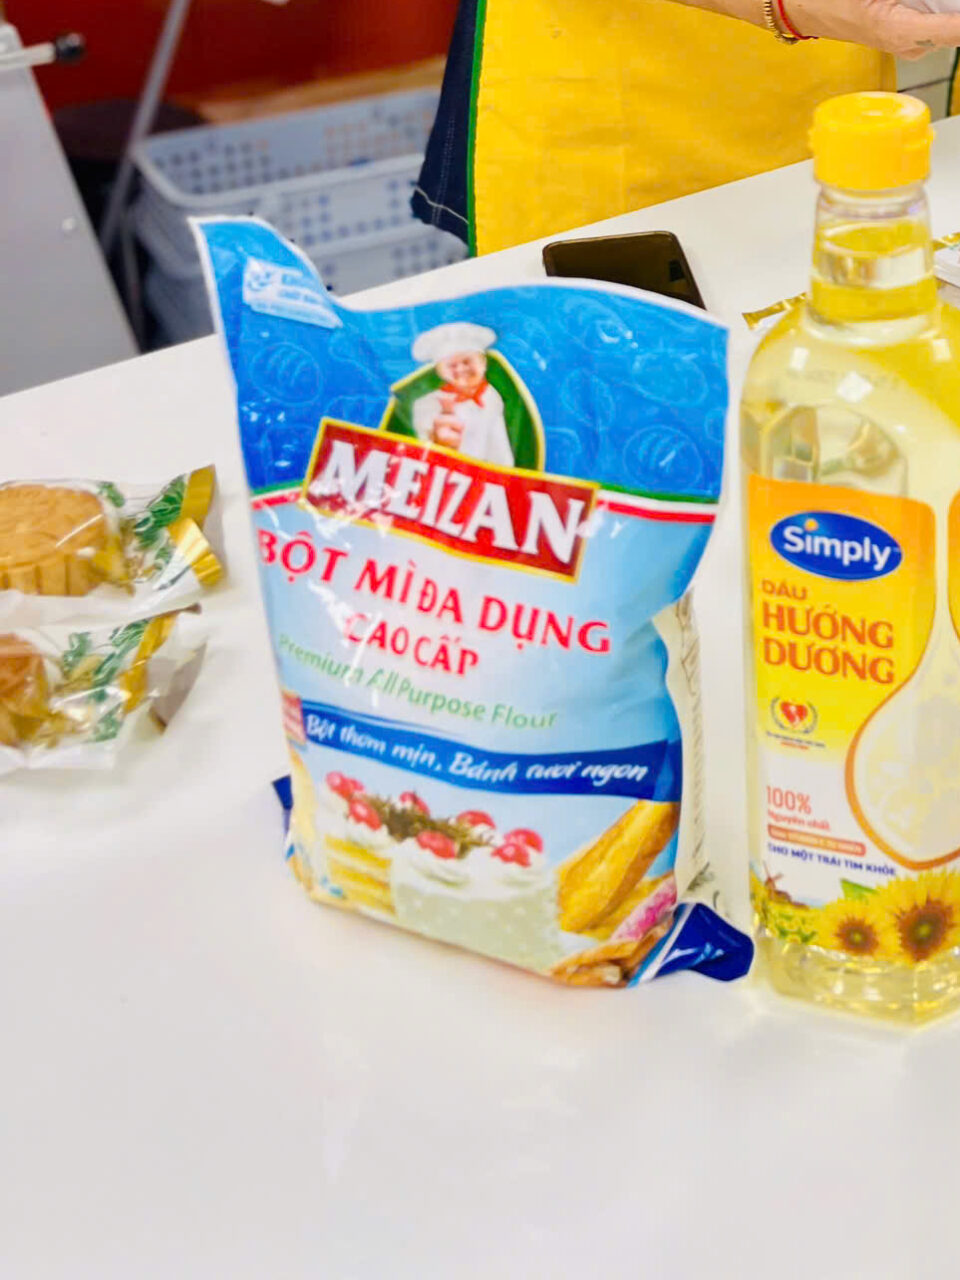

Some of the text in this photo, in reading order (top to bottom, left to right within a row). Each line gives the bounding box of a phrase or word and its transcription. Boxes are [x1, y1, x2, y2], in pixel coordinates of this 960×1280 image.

[309, 440, 586, 565] MEIZAN
[782, 518, 891, 571] Simply
[257, 528, 611, 654] BỘT MÌ ĐA DỤNG
[345, 612, 480, 676] CAO CẤP
[762, 601, 894, 650] HƯỚNG
[279, 632, 558, 730] Premium All Purpose Flour
[763, 636, 895, 685] DƯƠNG
[448, 751, 518, 783] Bánh
[581, 763, 649, 787] ngon
[766, 784, 812, 815] 100%
